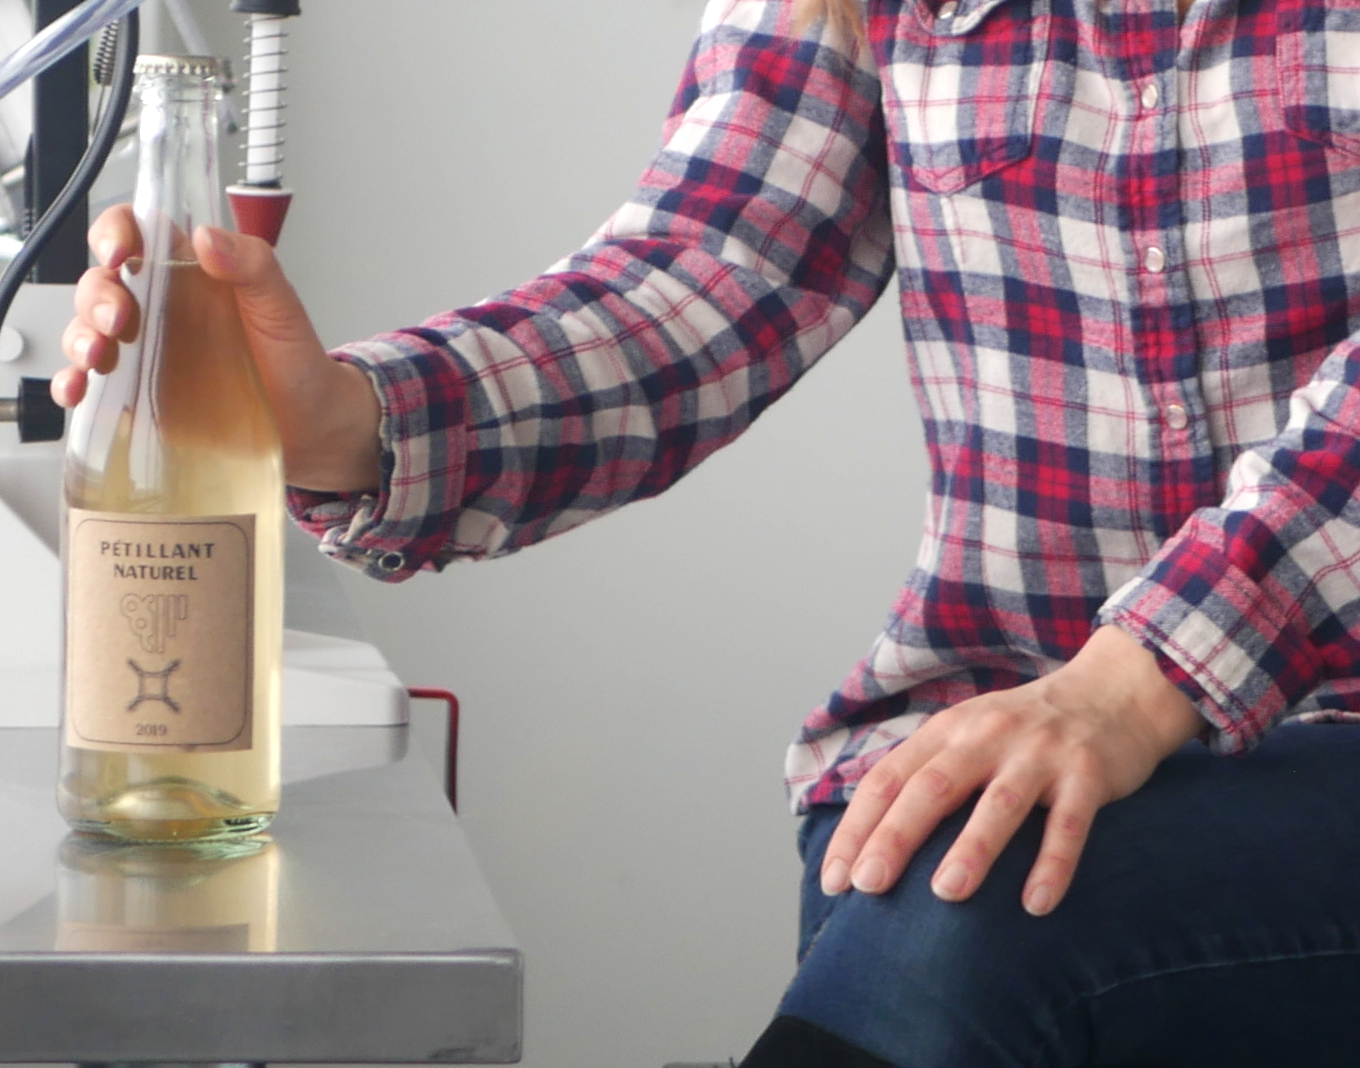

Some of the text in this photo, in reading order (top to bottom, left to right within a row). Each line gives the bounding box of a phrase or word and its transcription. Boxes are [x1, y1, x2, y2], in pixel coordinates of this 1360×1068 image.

[101, 539, 215, 559] PÉTILLANT
[113, 564, 198, 580] NATUREL
[136, 723, 168, 736] 2019
